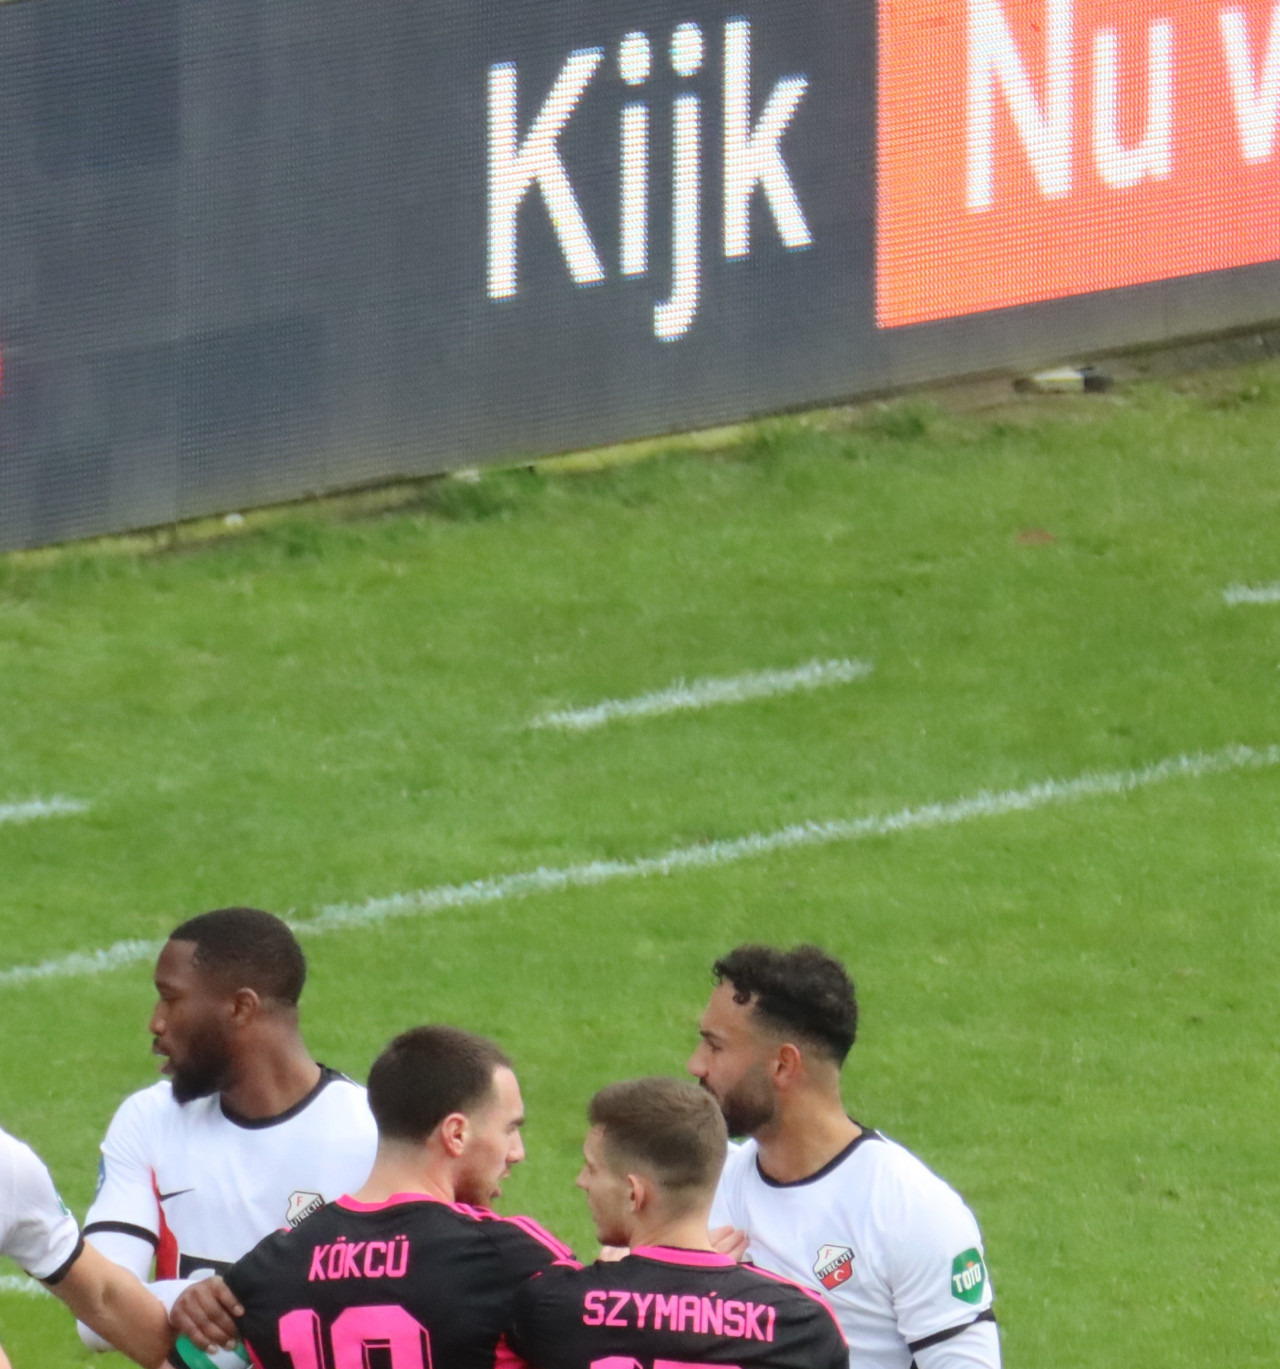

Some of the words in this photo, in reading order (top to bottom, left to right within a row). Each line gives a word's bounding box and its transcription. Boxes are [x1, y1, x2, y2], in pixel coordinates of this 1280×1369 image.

[966, 0, 1175, 213] Nu
[487, 16, 815, 342] Kijk
[308, 1234, 410, 1282] KÖKCÜ
[952, 1263, 982, 1294] TOTO
[582, 1290, 776, 1343] SZYMAŃSKI
